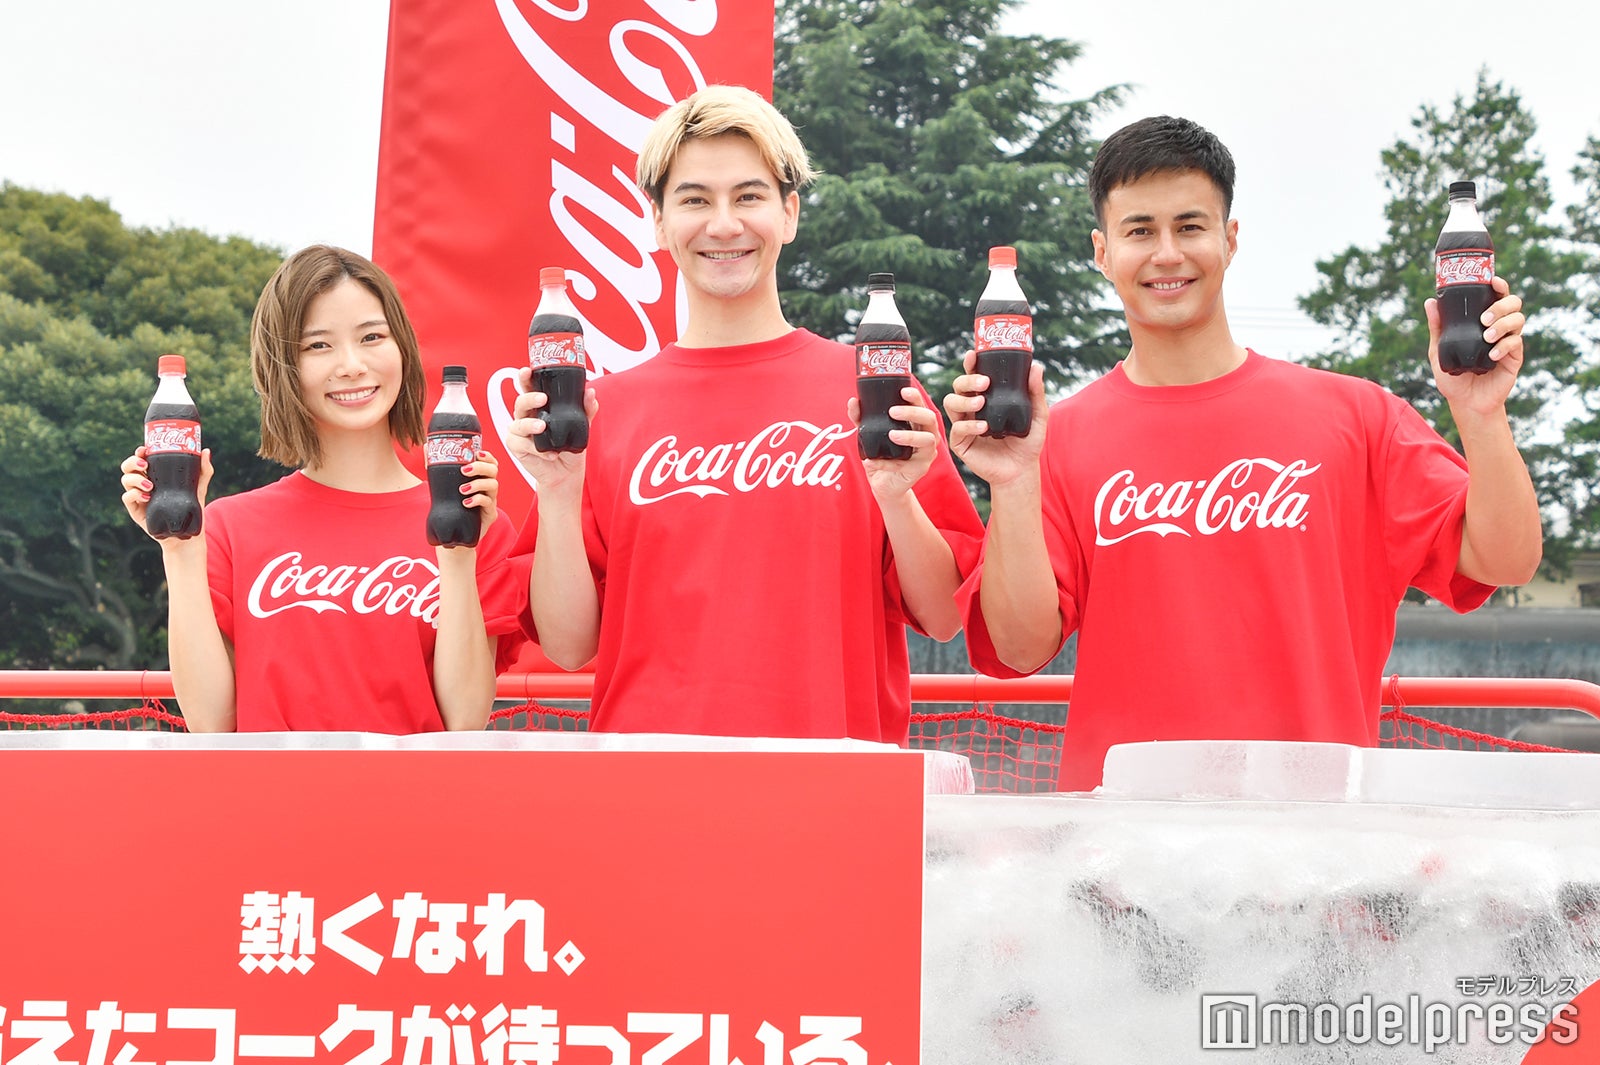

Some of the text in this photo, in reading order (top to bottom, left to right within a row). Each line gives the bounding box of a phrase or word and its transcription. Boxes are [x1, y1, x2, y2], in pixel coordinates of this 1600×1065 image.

[629, 421, 858, 506] Coca-Cola
[1094, 457, 1322, 547] Coca-Cola
[238, 890, 586, 977] 熱くなれ。
[0, 999, 893, 1065] えたコークが待っている
